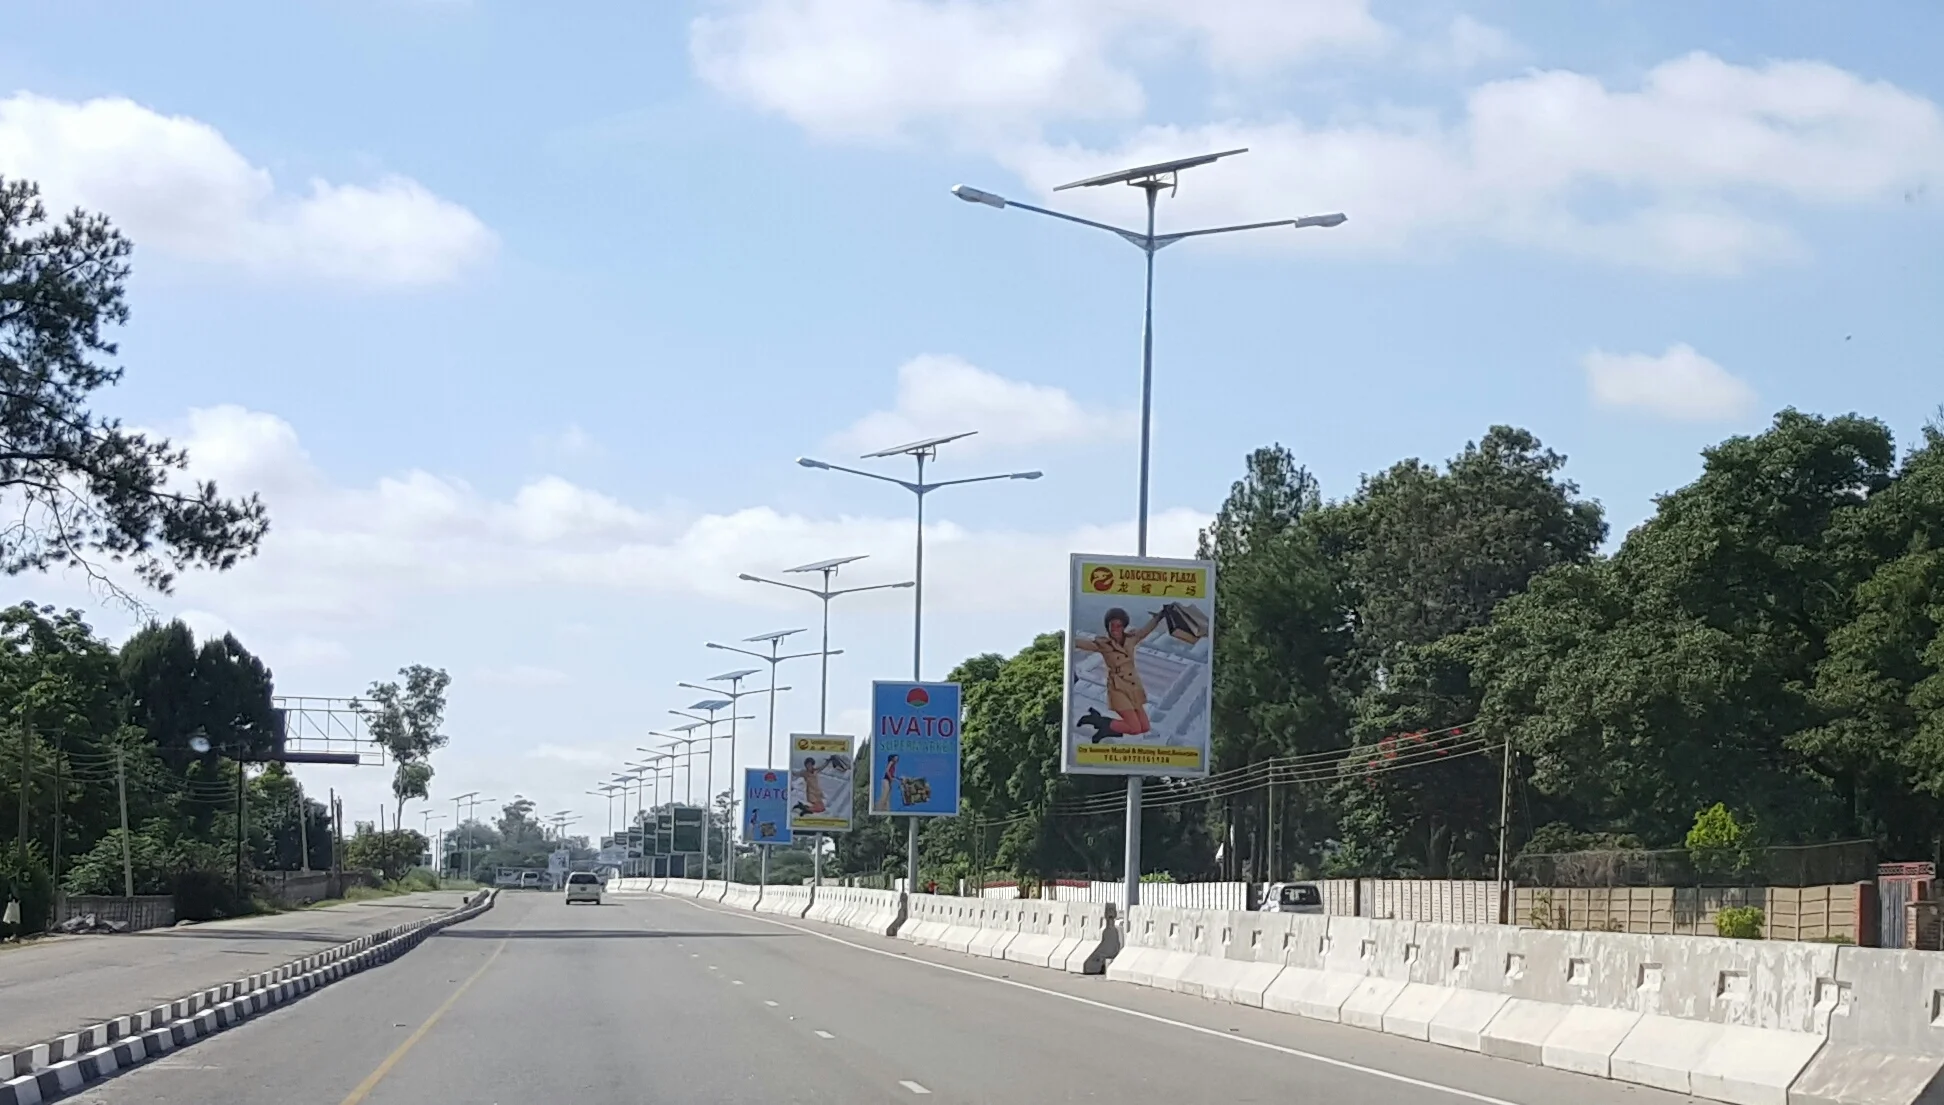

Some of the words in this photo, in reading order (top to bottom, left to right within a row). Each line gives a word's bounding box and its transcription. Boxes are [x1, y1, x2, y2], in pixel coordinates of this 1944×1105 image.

[1119, 568, 1168, 582] LONGCHENG
[1170, 571, 1197, 584] PLAZA
[881, 716, 955, 738] IVATO
